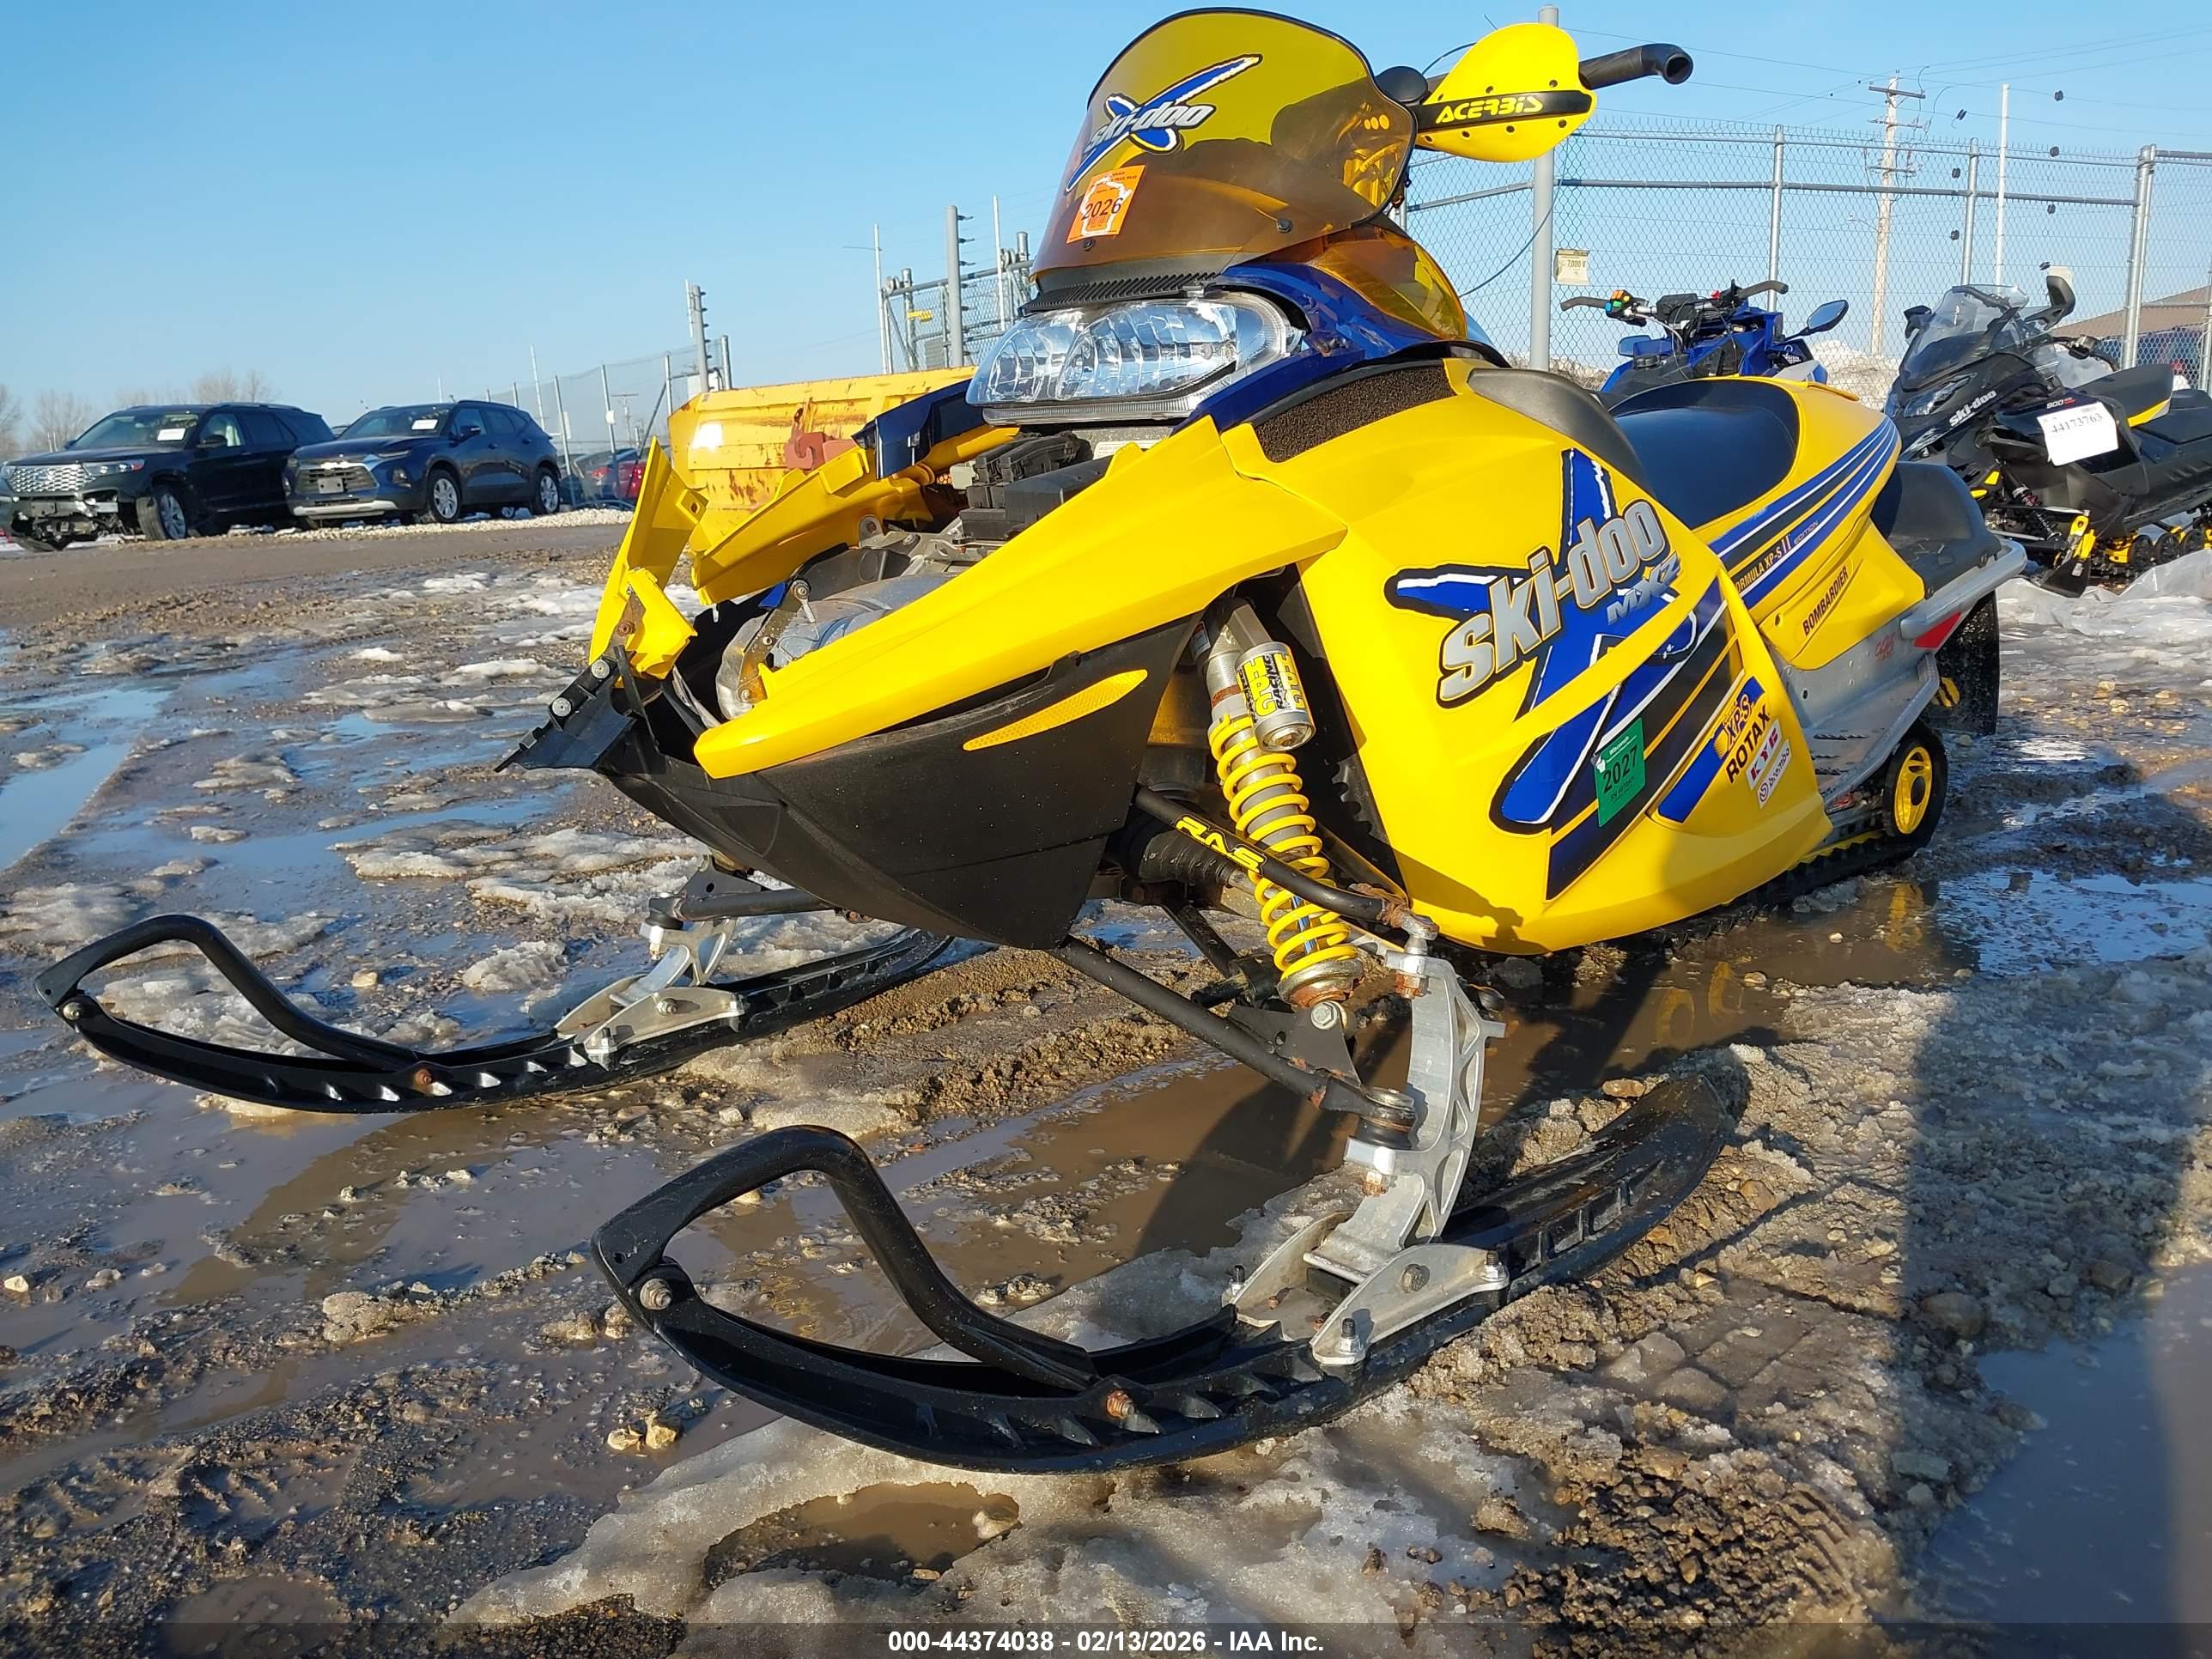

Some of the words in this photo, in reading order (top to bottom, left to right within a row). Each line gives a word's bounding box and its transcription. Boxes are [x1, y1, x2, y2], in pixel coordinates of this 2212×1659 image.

[1082, 198, 1123, 221] 2026
[1794, 520, 1820, 544] EDITION
[1802, 564, 1850, 637] BOMBARDIER
[1726, 704, 1771, 783] ROTAX
[1603, 744, 1638, 793] 2027
